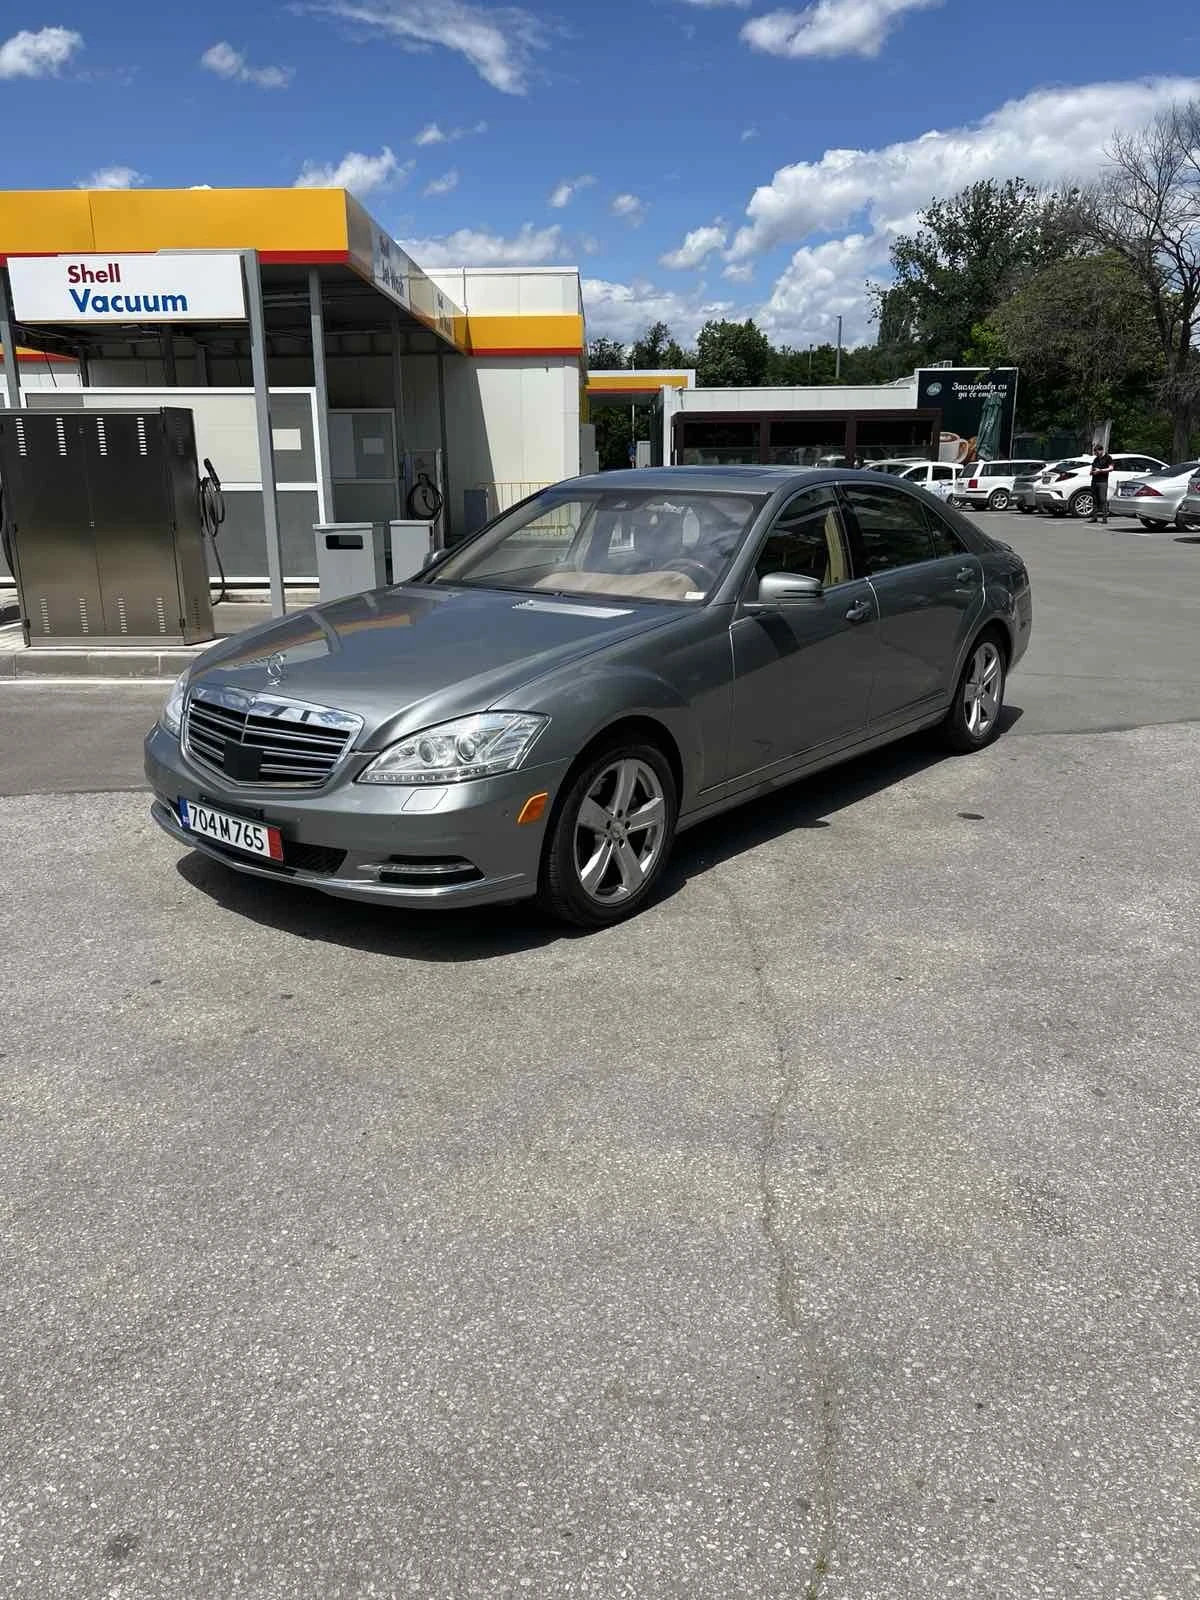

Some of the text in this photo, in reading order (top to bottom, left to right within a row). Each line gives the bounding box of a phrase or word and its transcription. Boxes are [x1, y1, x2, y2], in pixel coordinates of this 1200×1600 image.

[67, 263, 121, 283] Shell
[69, 288, 188, 313] Vacuum
[951, 381, 996, 392] Заслужава
[189, 805, 264, 851] 704M765
